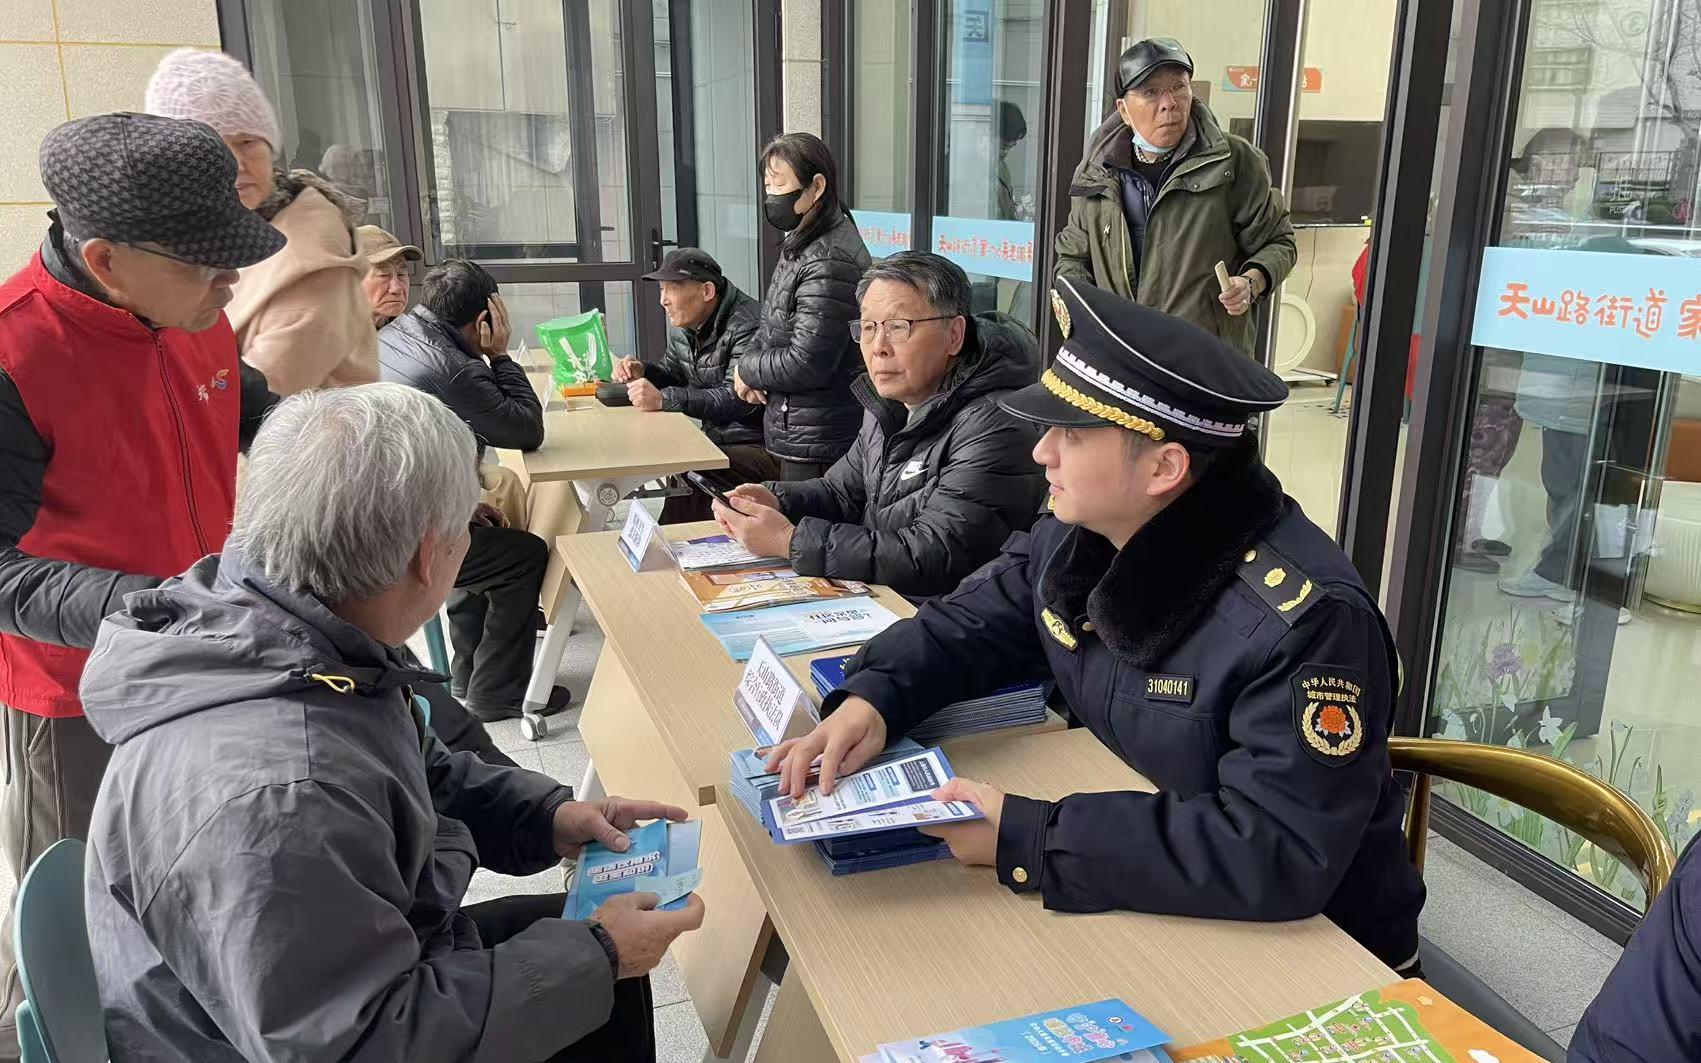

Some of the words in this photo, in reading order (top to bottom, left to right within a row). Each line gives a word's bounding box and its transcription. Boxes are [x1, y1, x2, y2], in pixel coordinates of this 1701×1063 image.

[1497, 281, 1669, 341] 天山路街道
[1147, 678, 1188, 696] 31040141
[1301, 676, 1362, 697] 中华人民共和国
[1306, 689, 1358, 704] 城市管理执法
